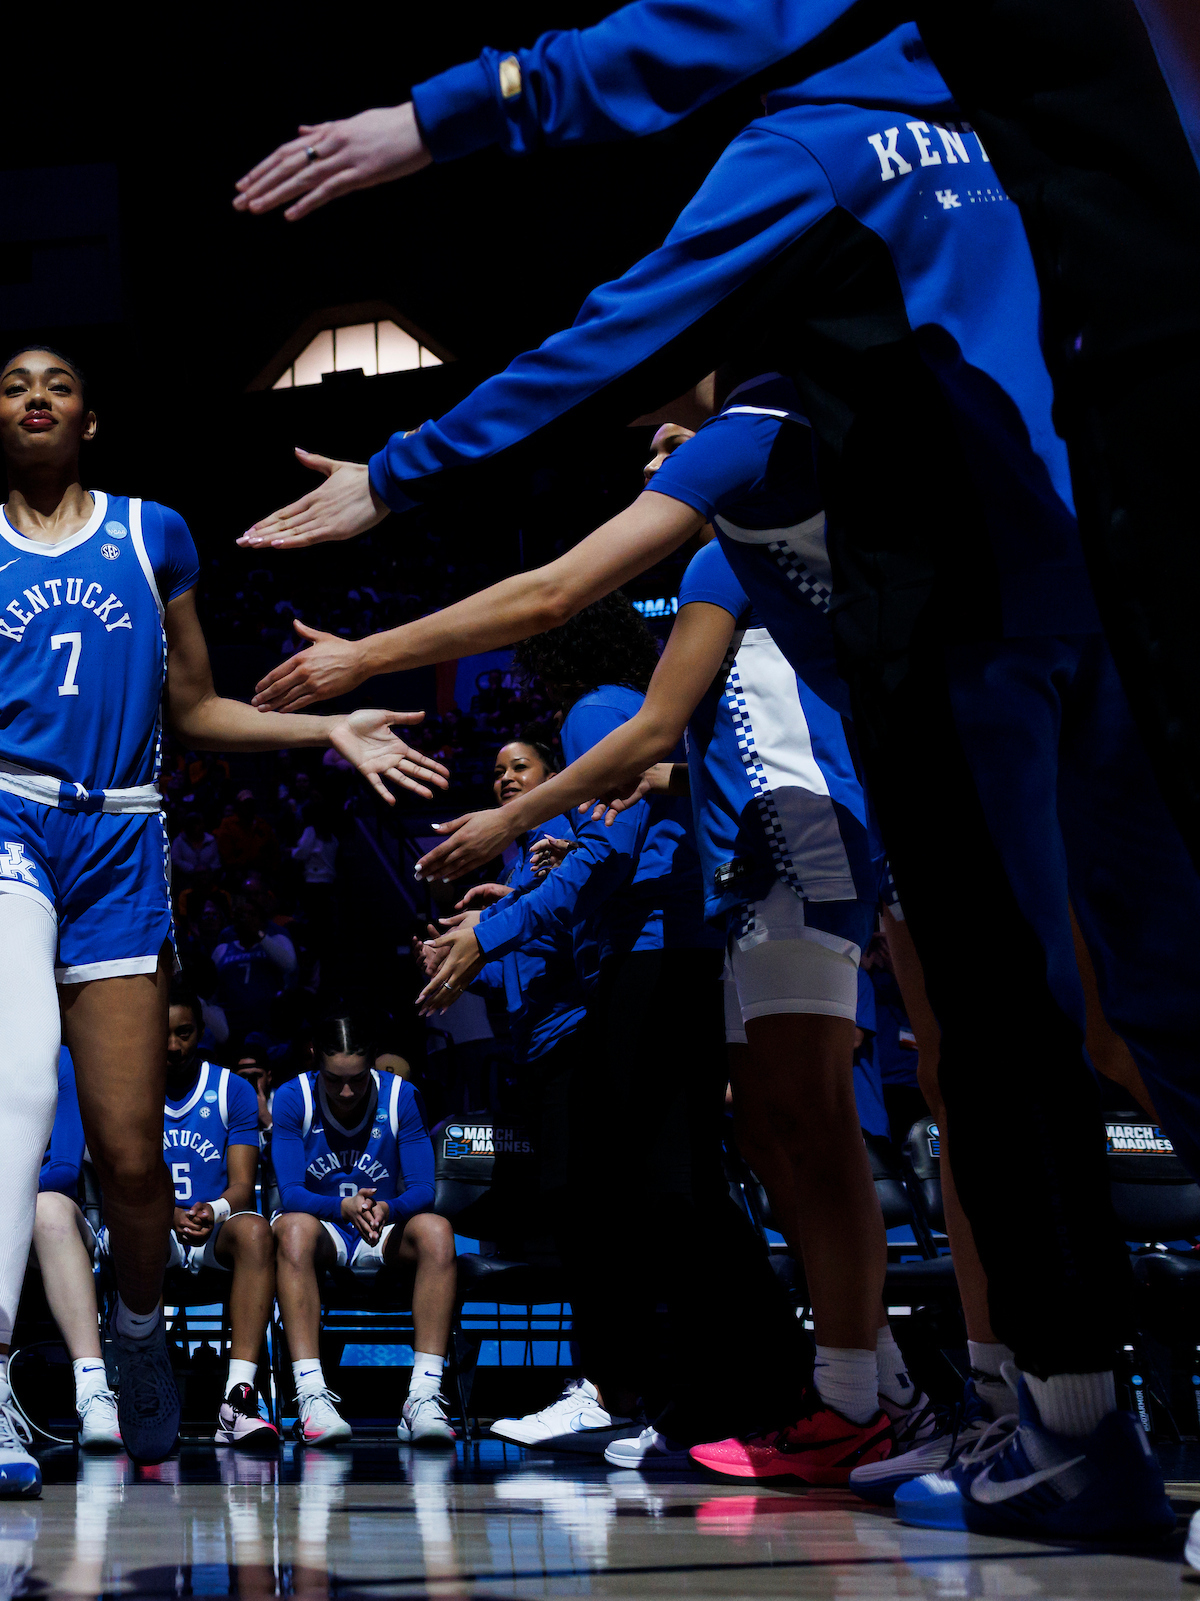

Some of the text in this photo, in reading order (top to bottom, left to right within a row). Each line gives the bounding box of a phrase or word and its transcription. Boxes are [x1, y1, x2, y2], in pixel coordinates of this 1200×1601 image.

[102, 545, 119, 559] SEC
[50, 631, 83, 697] 7
[238, 962, 251, 985] 7
[463, 1127, 514, 1141] MARCH
[1105, 1126, 1154, 1139] MARCH
[471, 1140, 534, 1153] MADNES
[306, 1149, 390, 1183] KENTUCKY
[171, 1162, 194, 1201] 5
